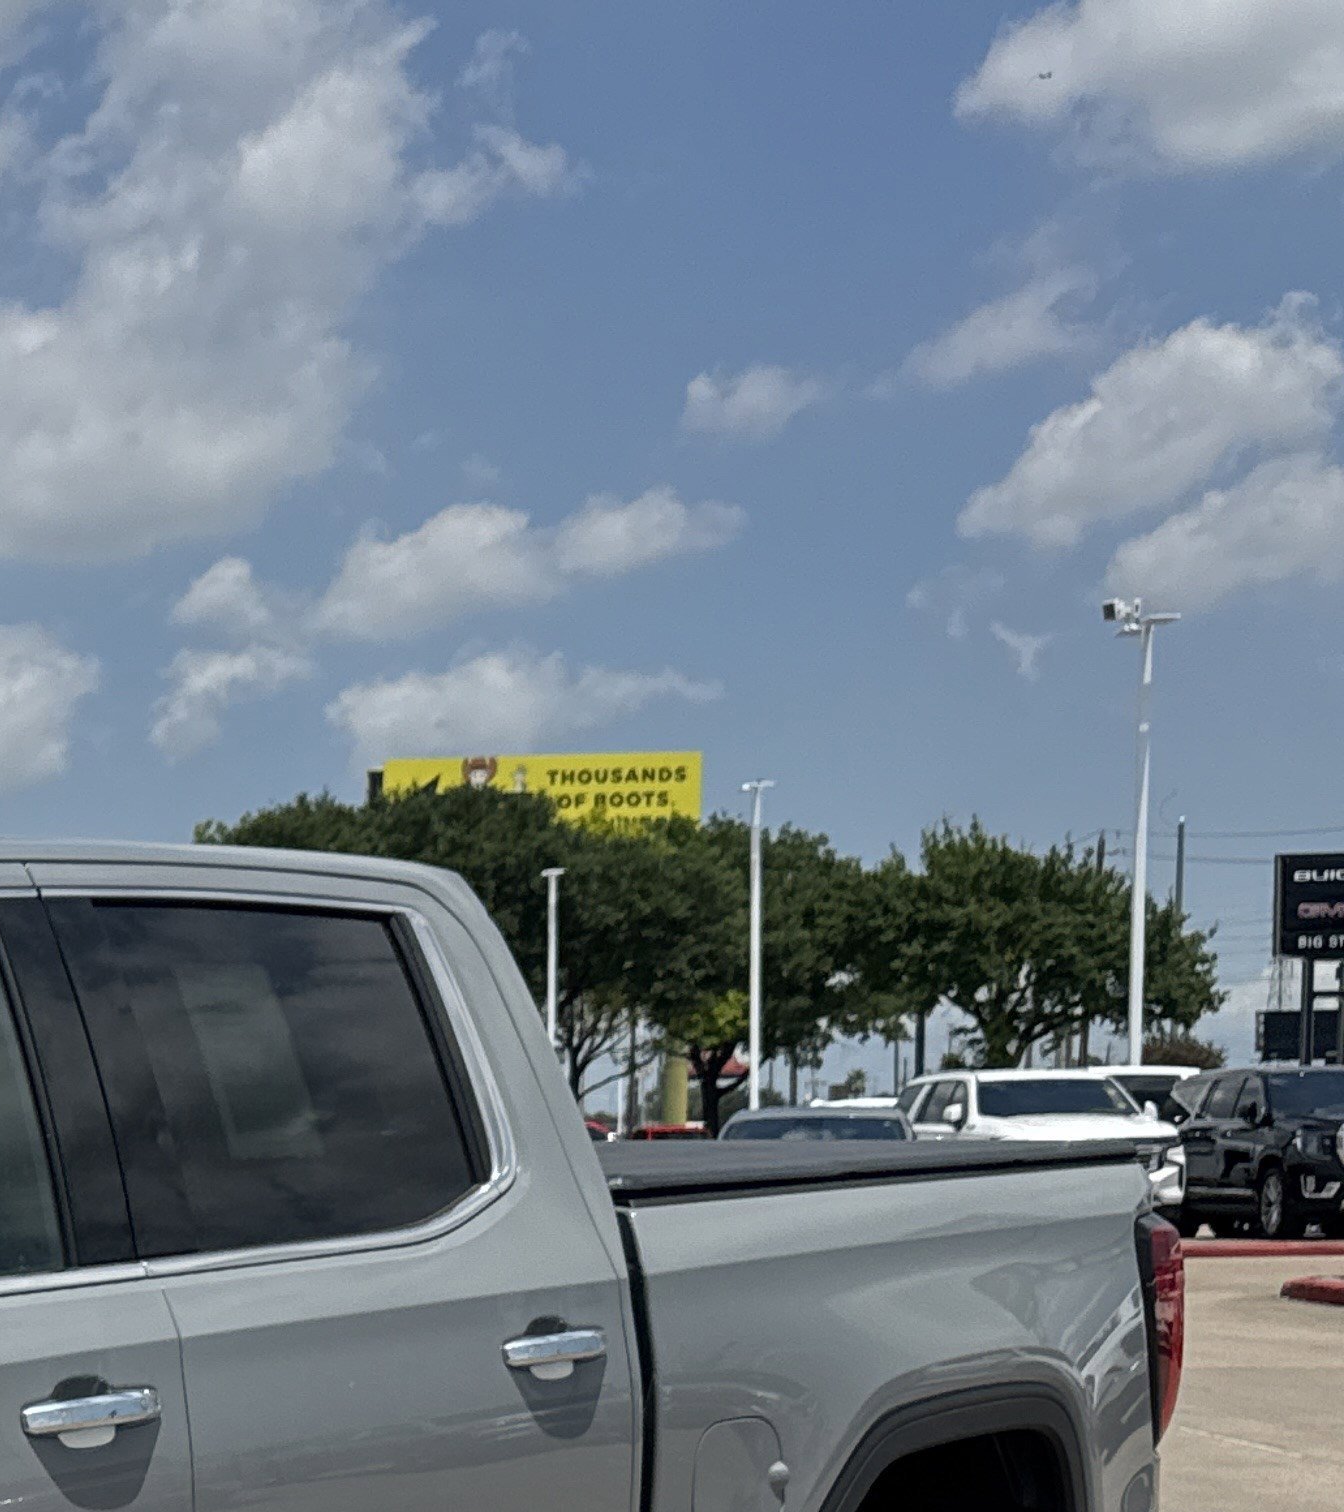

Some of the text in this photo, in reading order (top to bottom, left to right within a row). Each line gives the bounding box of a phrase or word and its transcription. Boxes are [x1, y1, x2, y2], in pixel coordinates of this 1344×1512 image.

[546, 765, 687, 786] THOUSANDS
[556, 790, 669, 809] OF ROOTS
